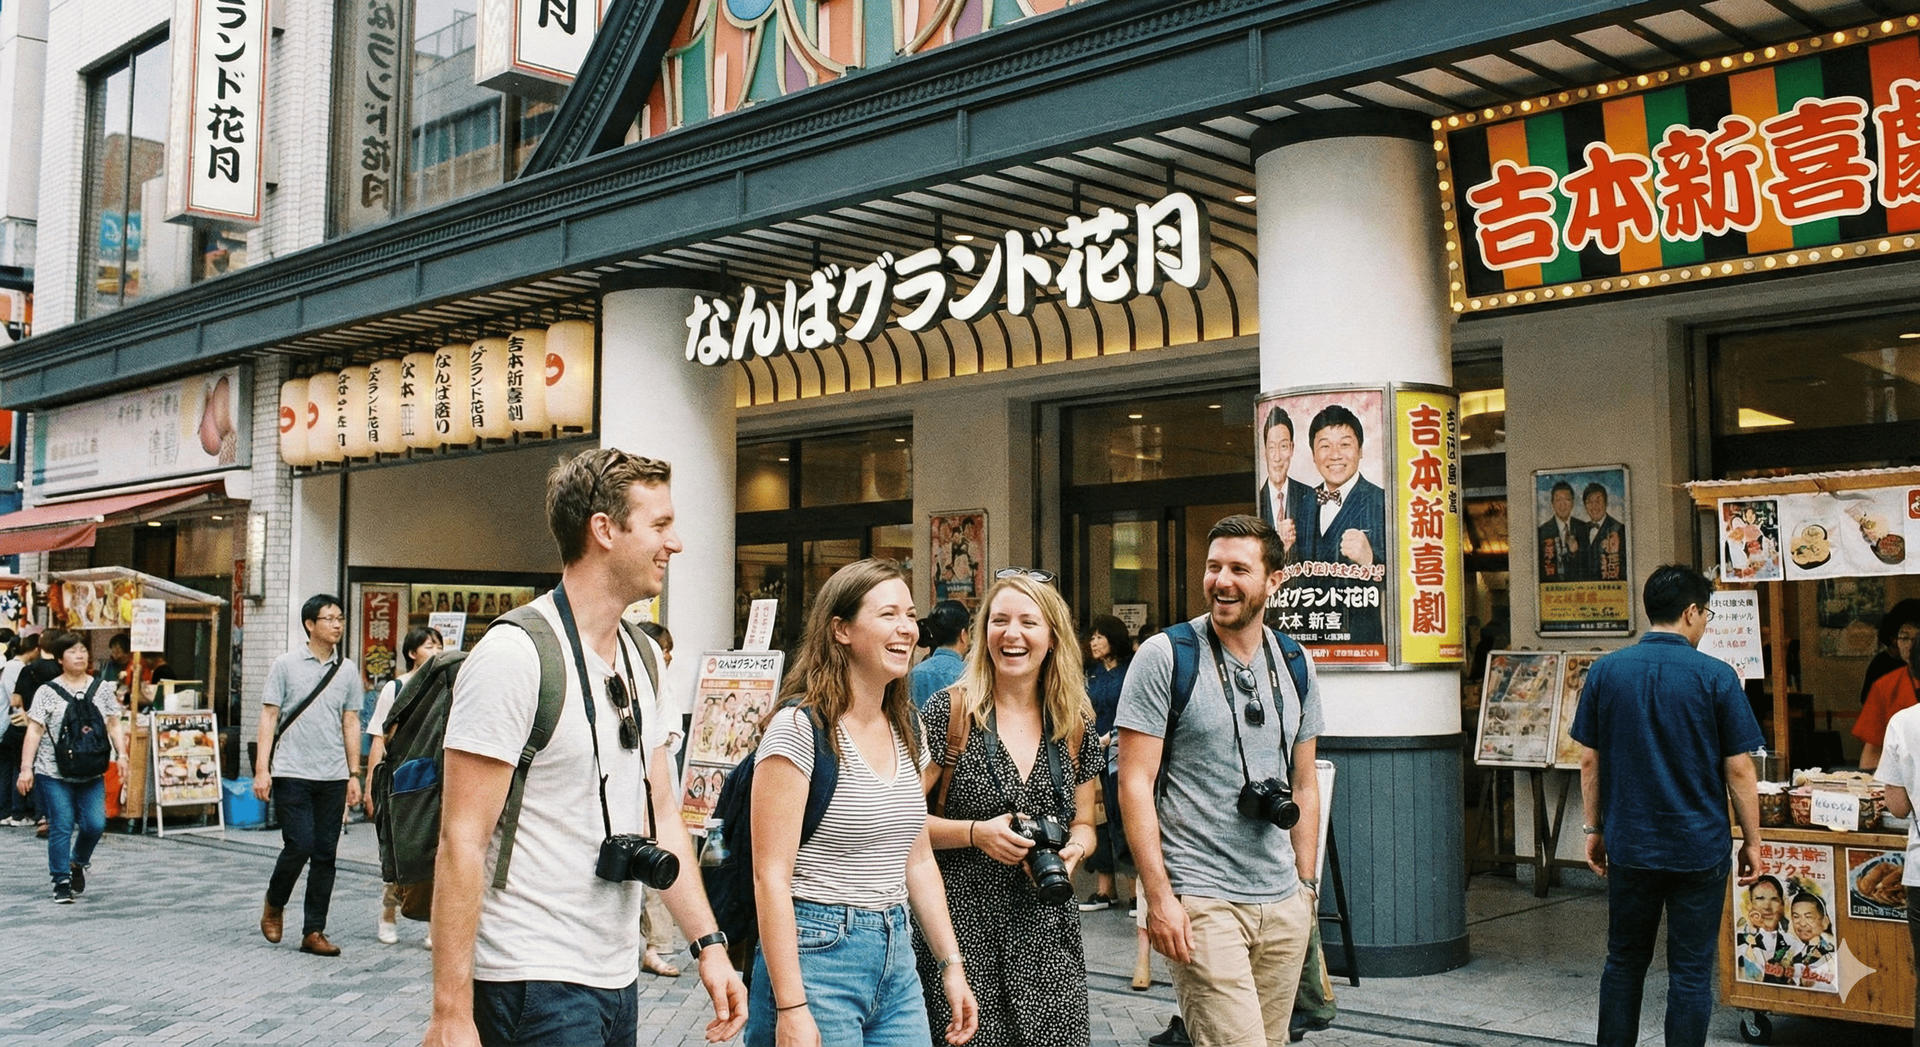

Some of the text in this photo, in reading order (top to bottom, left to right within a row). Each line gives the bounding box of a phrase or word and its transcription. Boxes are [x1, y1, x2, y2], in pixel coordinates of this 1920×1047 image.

[207, 0, 247, 184] ランド花月
[685, 192, 1205, 366] なんばグランド花月
[1408, 403, 1446, 635] 吉本新喜劇
[1279, 611, 1342, 630] 大本 新喜
